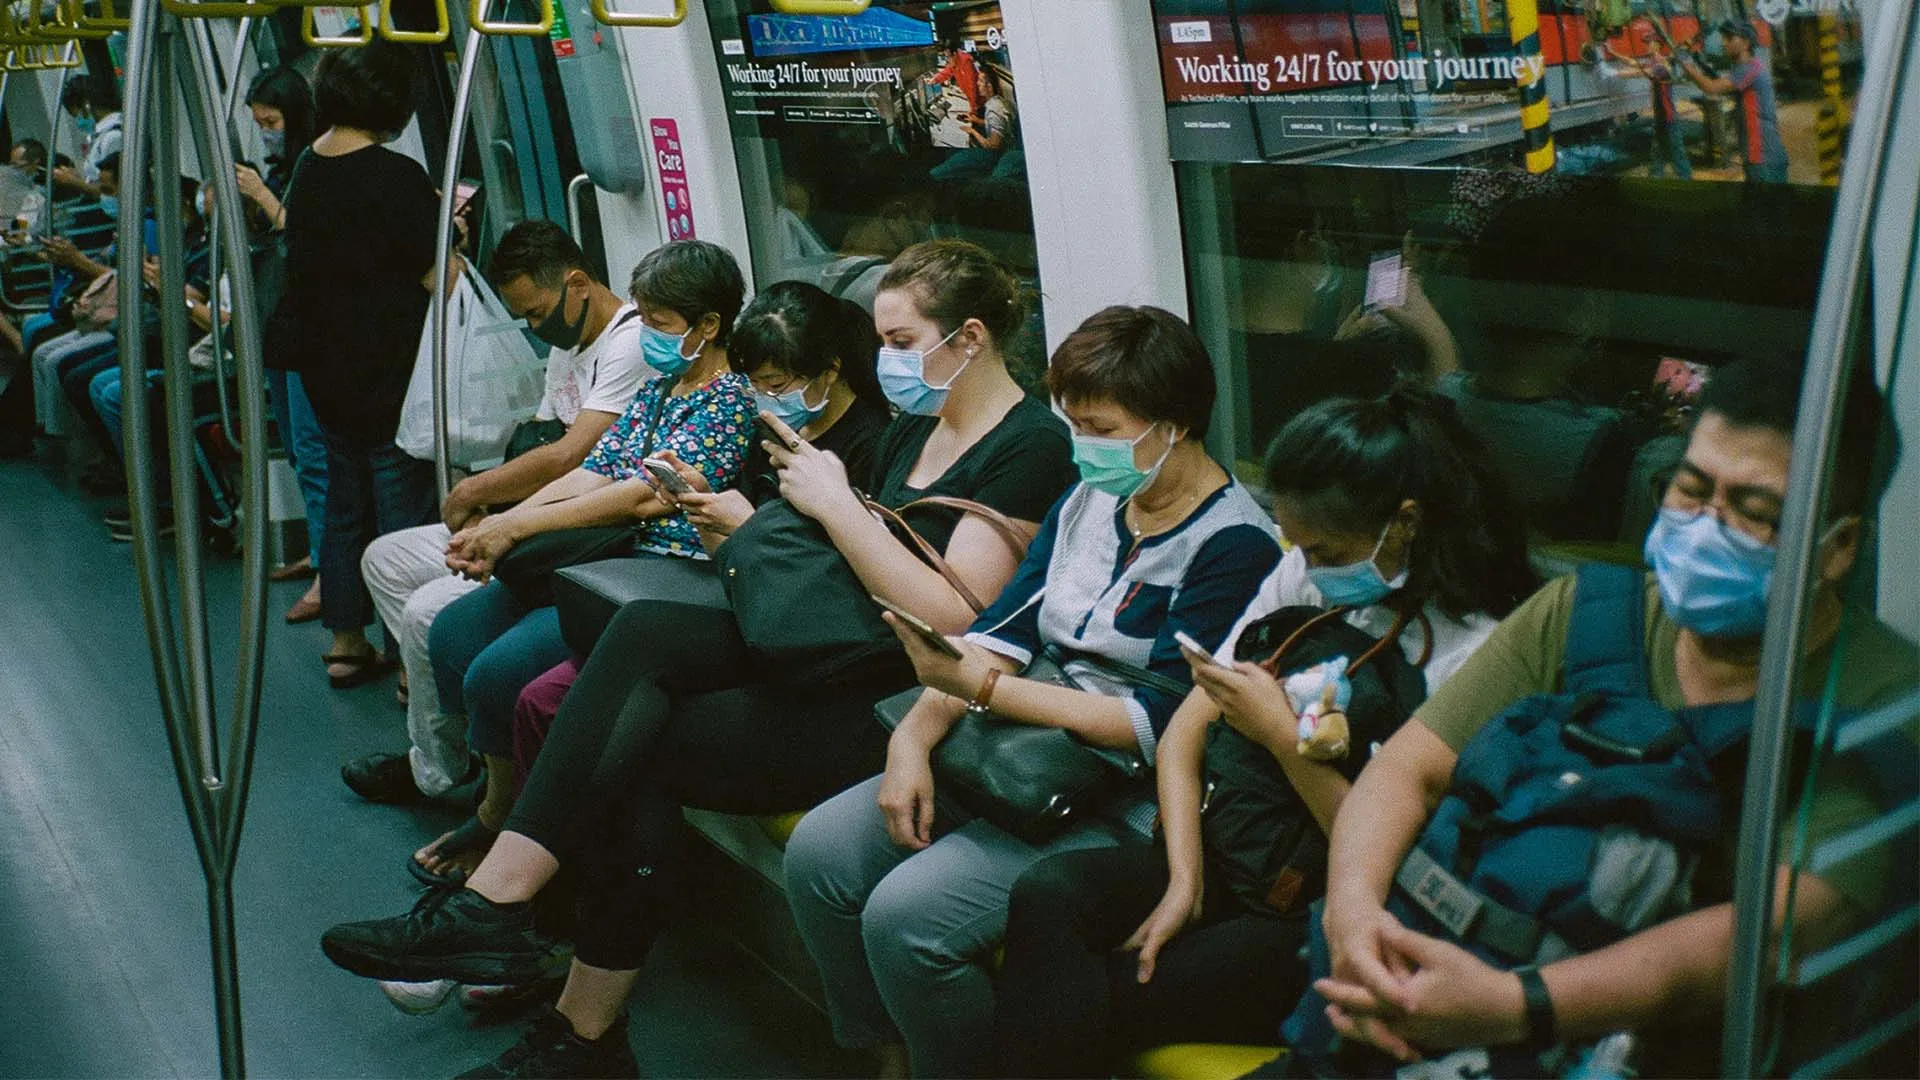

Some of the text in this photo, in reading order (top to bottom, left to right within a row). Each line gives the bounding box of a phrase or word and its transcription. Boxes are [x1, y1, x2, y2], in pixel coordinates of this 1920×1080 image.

[727, 61, 902, 89] Working 24/7 for your journey
[1175, 49, 1544, 92] Working 24/7 for your journey
[658, 150, 683, 172] Care
